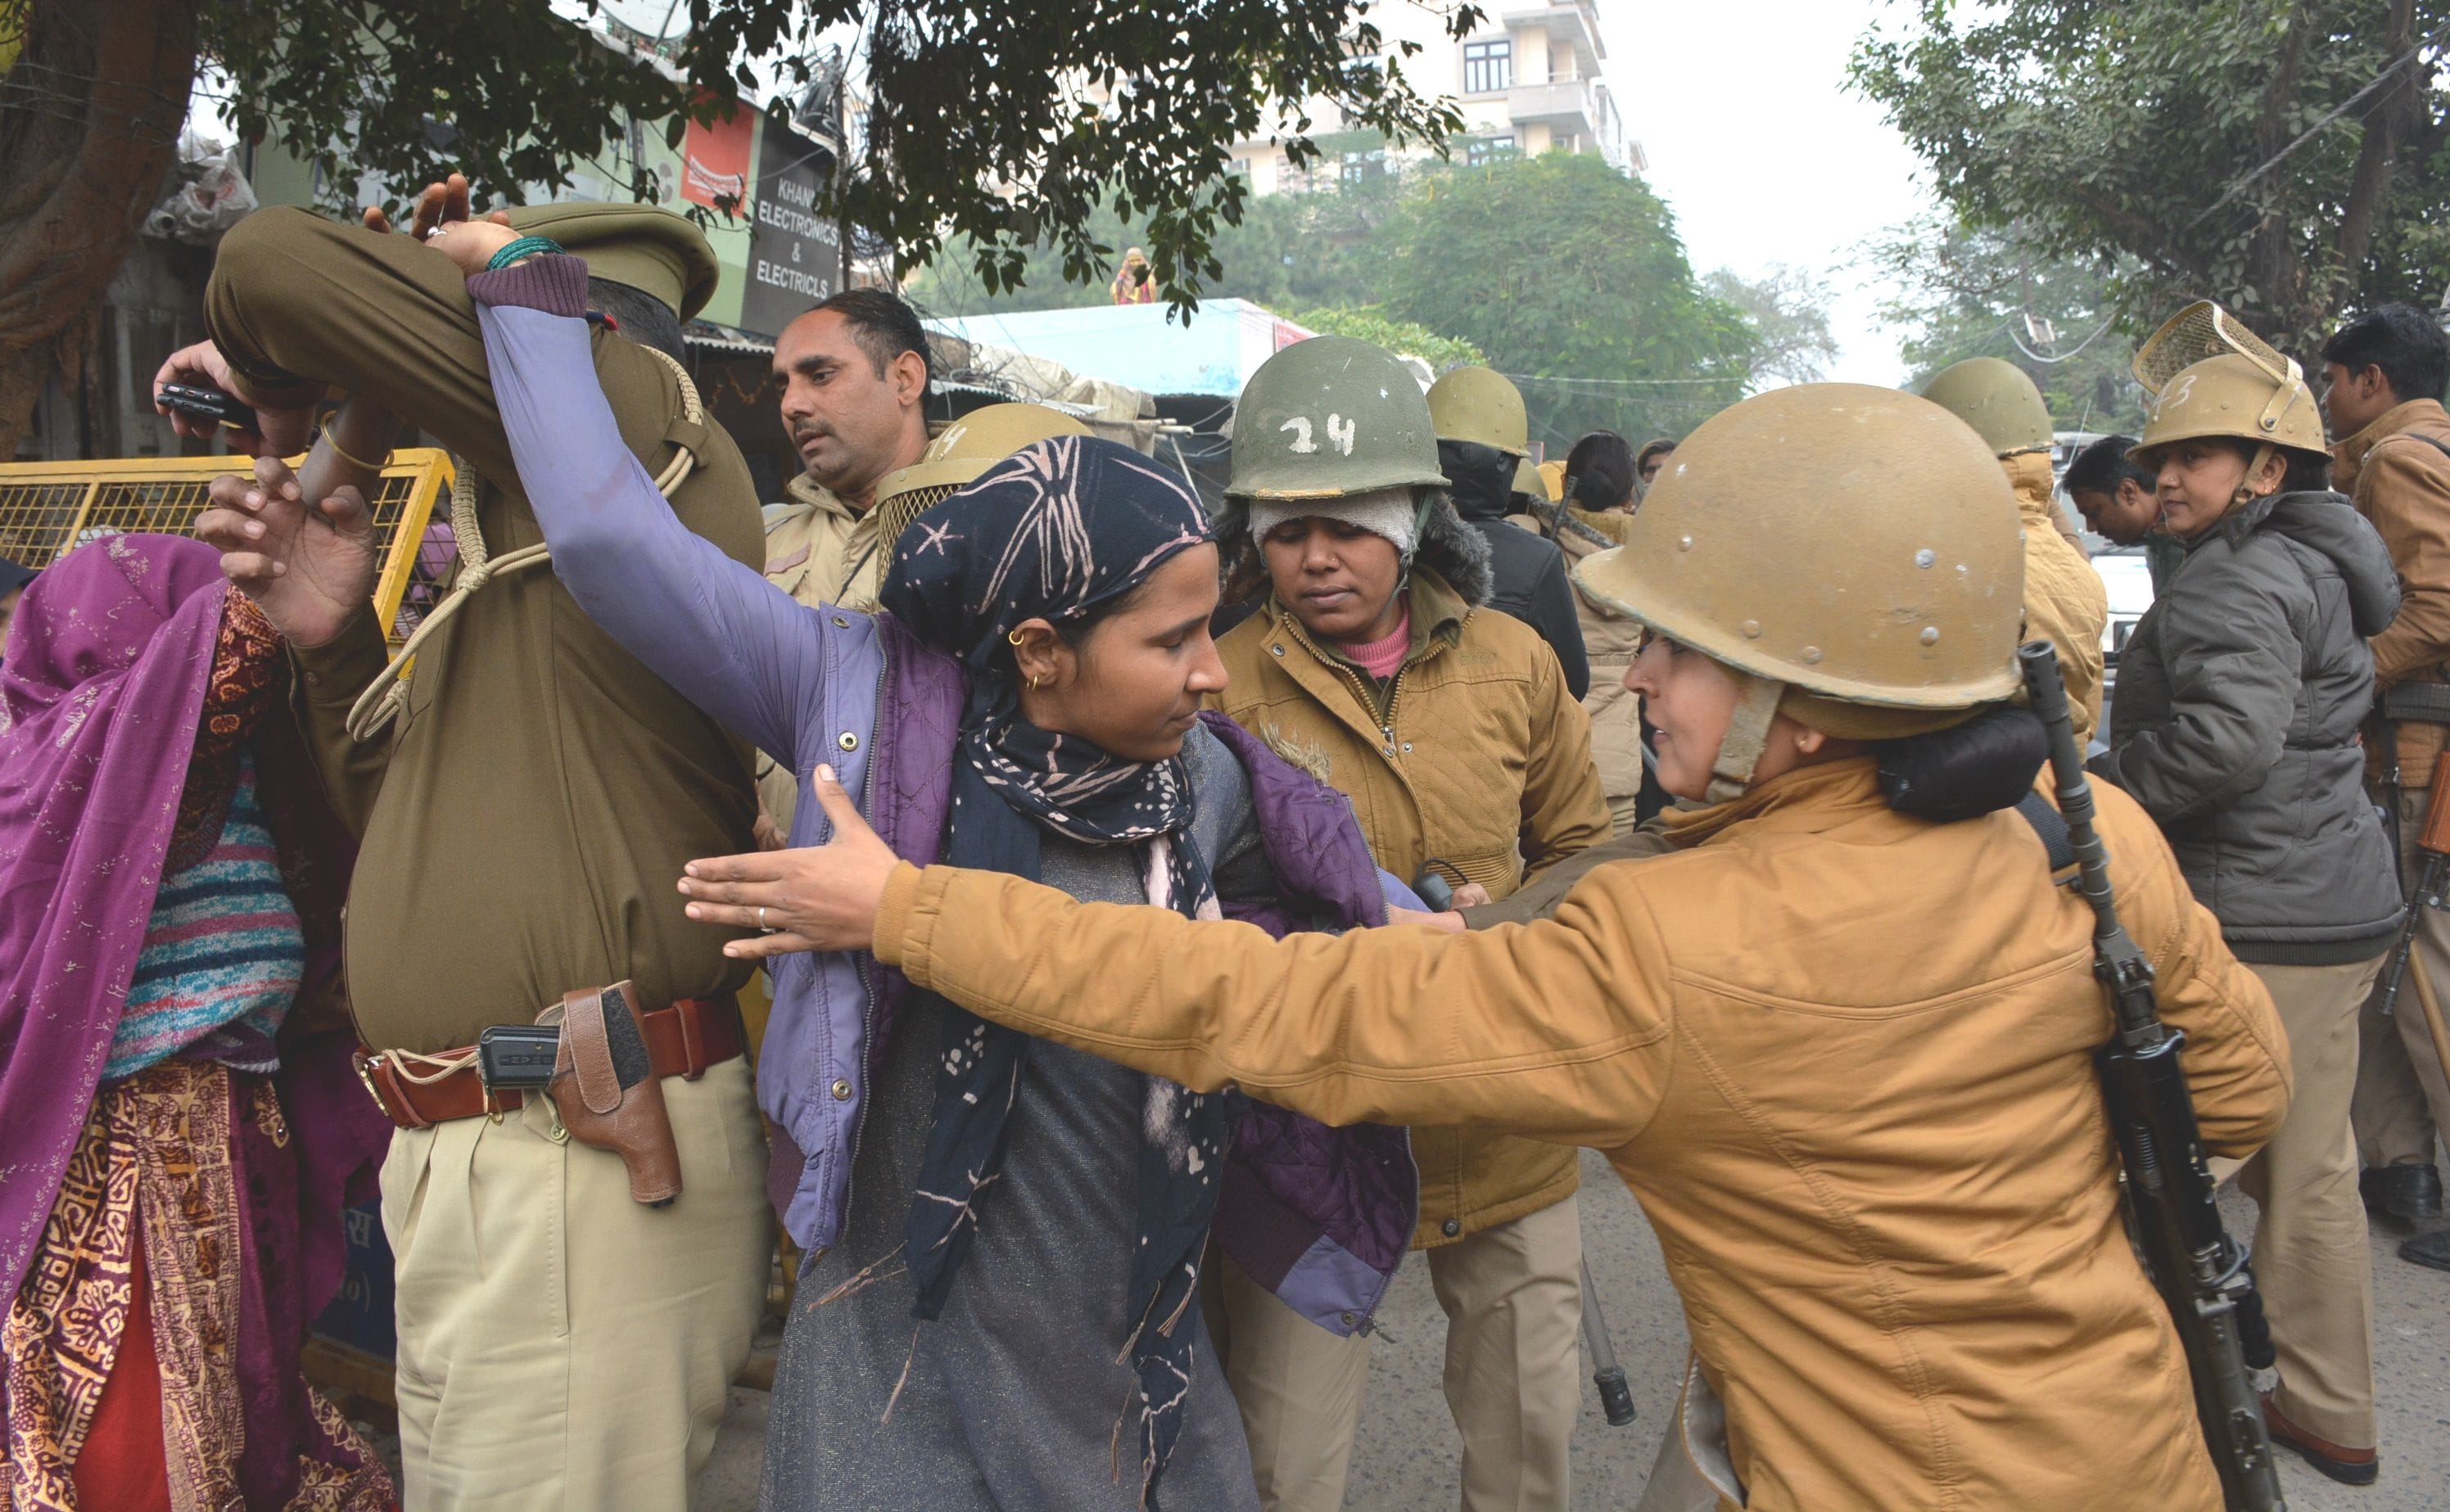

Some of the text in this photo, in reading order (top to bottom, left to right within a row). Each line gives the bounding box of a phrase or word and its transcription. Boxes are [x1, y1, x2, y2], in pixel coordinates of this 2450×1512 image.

[778, 177, 820, 211] KHAN
[758, 200, 839, 246] ELECTRONICS
[792, 241, 801, 263] &
[757, 260, 828, 300] ELECTRICLS
[1279, 413, 1355, 457] 24
